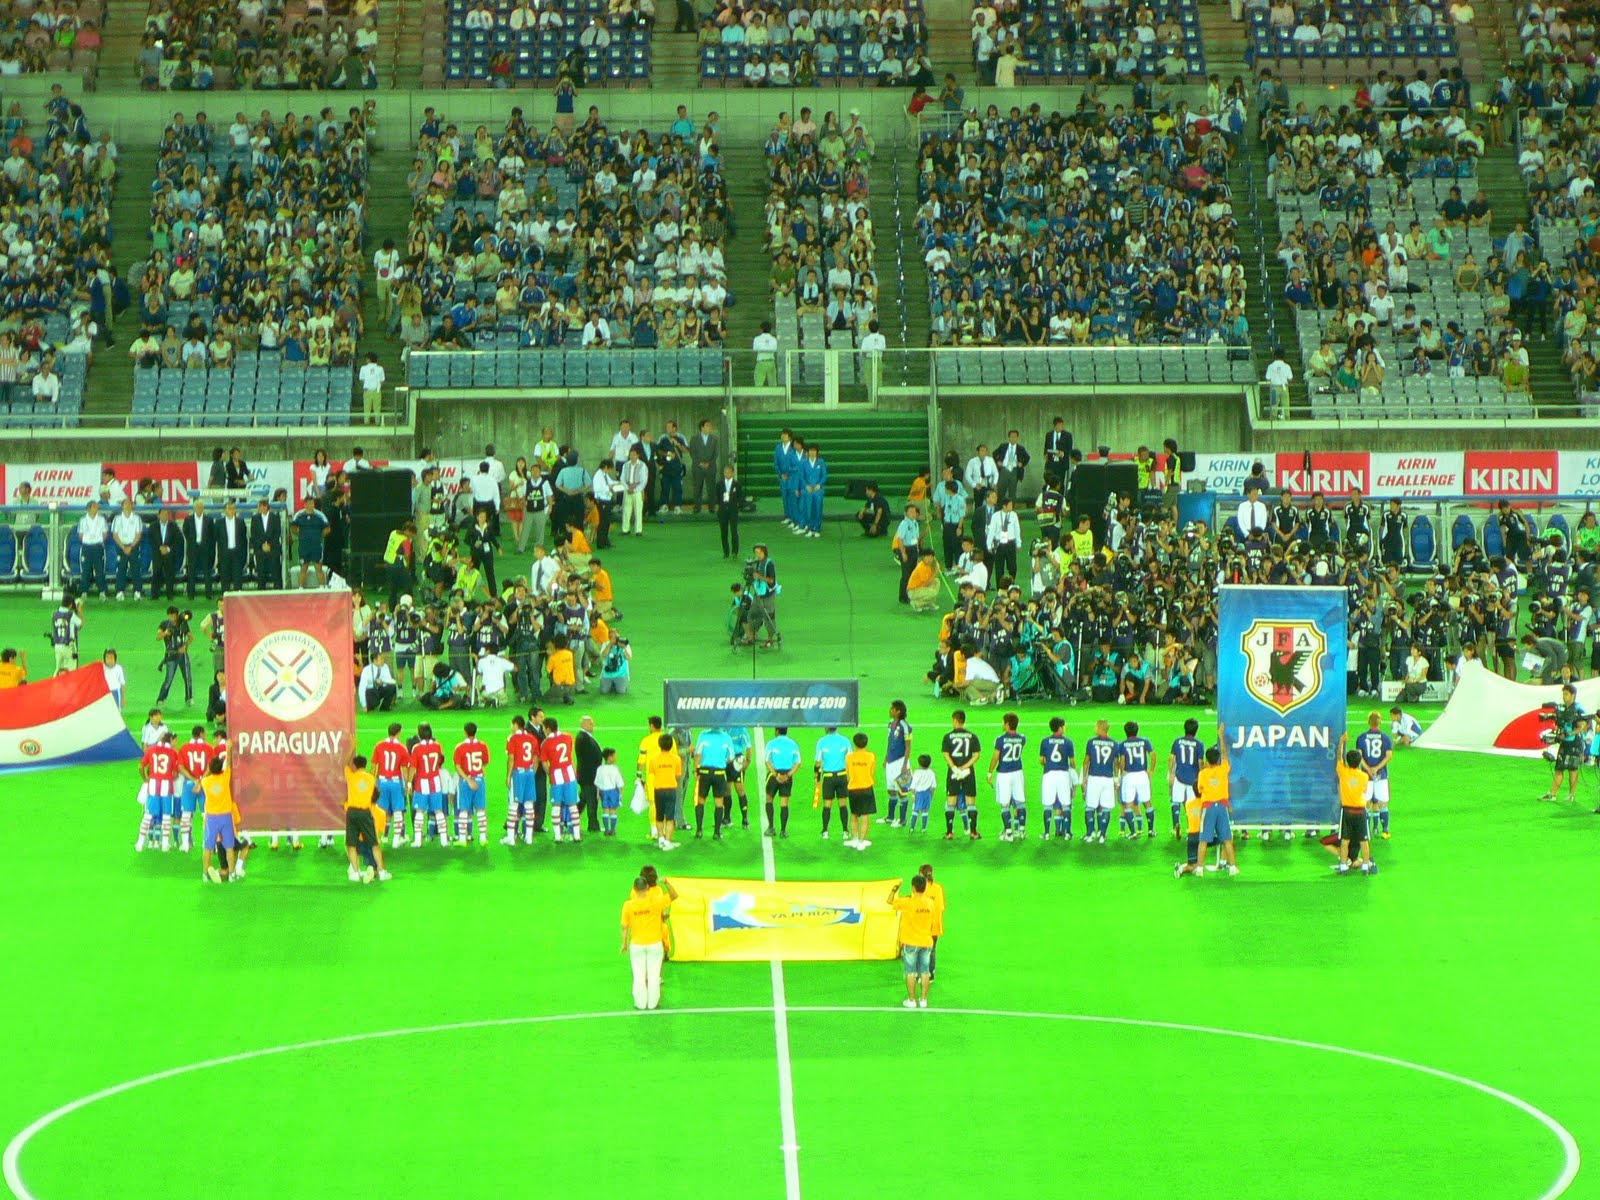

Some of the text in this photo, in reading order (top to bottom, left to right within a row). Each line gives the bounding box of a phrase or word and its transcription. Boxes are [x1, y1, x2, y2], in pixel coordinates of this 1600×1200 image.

[1209, 459, 1250, 471] KIRIN
[1397, 459, 1437, 469] KIRIN
[33, 470, 73, 481] KIRIN
[1282, 469, 1364, 492] KIRIN
[1376, 474, 1456, 487] CHALLENGE
[1471, 468, 1553, 491] KIRIN
[13, 486, 92, 498] CALLENGE
[1256, 632, 1312, 647] JFA
[677, 696, 847, 710] KIRIN CHALLENGE CUP 2010
[238, 731, 343, 755] PARAGUAY
[1232, 725, 1330, 749] JAPAN
[522, 741, 533, 762] 3
[556, 743, 568, 763] 2
[951, 738, 970, 757] 21
[1002, 743, 1022, 762] 20
[1050, 743, 1062, 762] 6
[1095, 744, 1112, 765] 19
[1126, 746, 1145, 766] 14
[1180, 744, 1194, 765] 11
[1365, 738, 1383, 758] 18
[152, 753, 169, 774] 13
[187, 751, 206, 772] 14
[383, 750, 397, 772] 11
[422, 752, 439, 774] 17
[465, 751, 483, 772] 15
